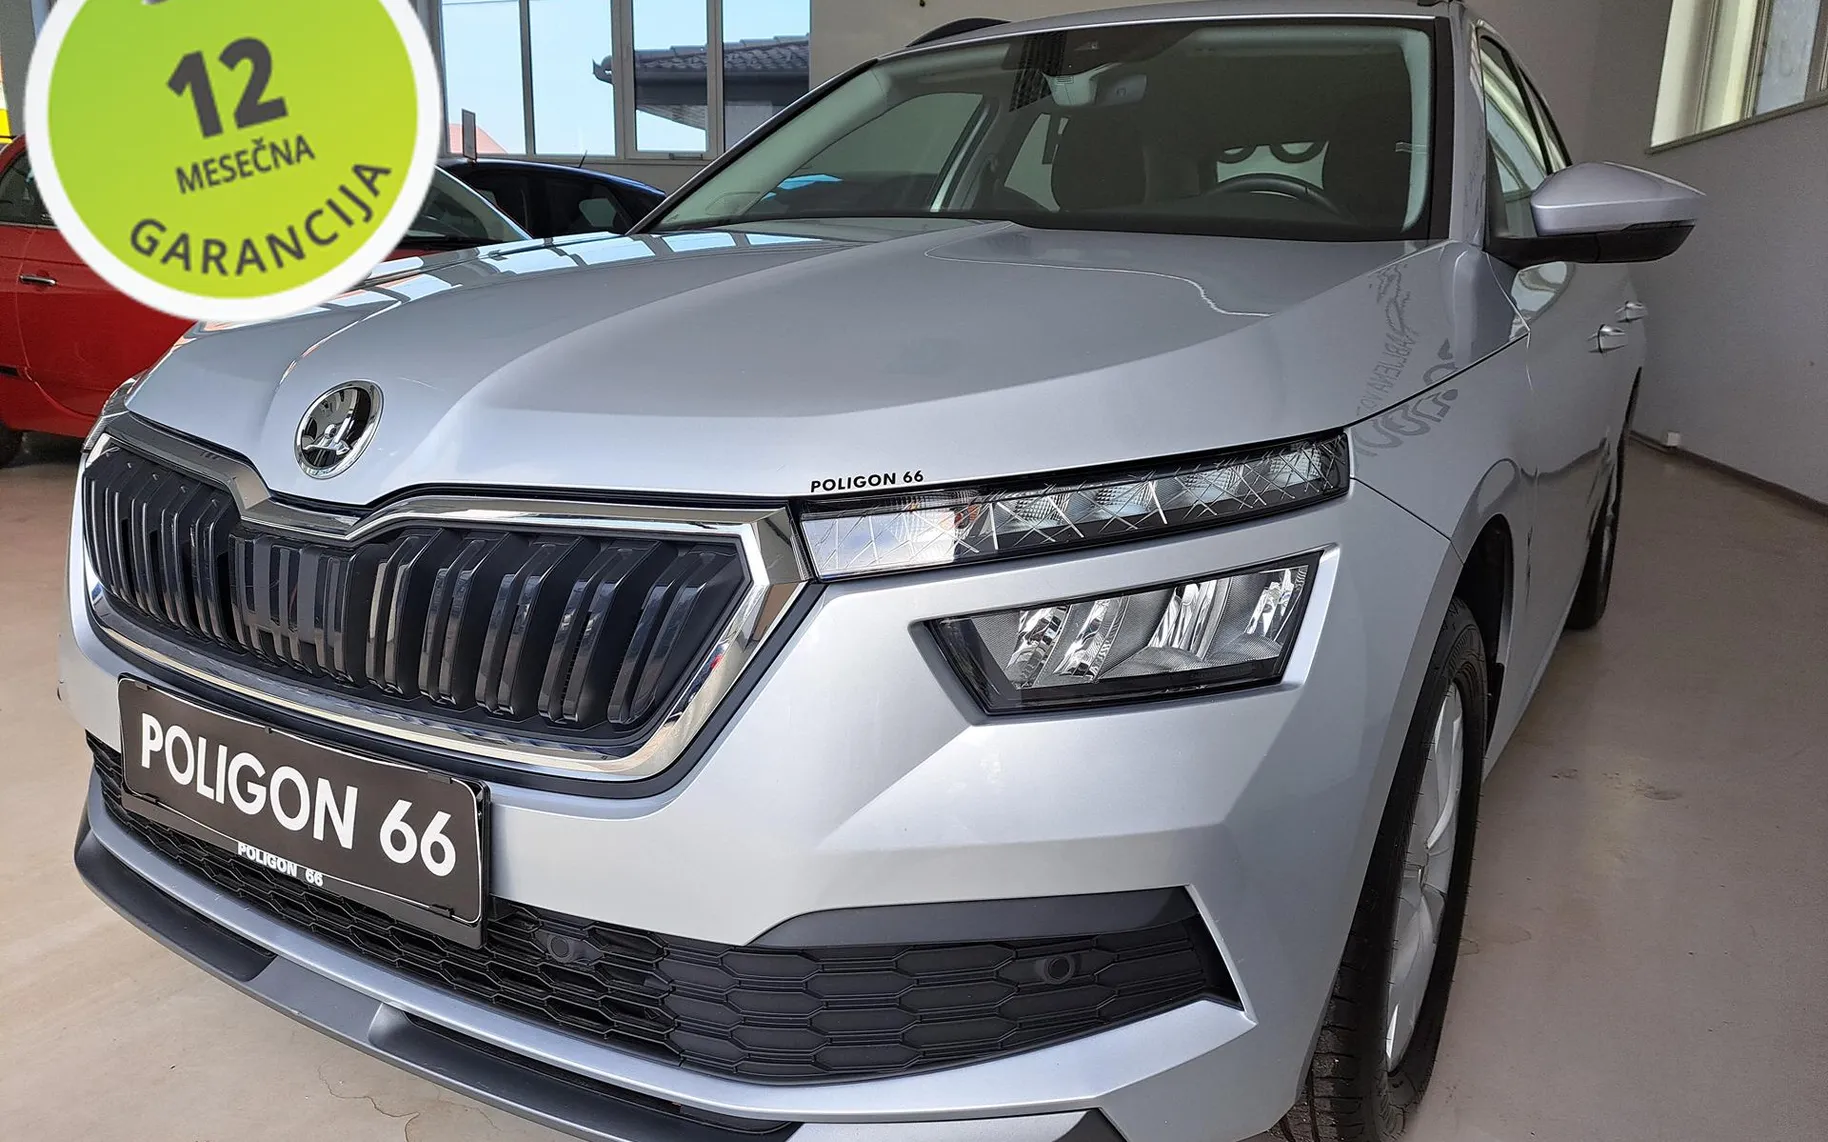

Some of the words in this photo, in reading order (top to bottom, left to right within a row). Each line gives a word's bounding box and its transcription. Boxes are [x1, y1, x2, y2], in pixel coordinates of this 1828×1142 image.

[811, 472, 896, 493] POLIGON
[902, 470, 924, 483] 66
[141, 712, 359, 851] POLIGON
[380, 799, 457, 877] 66
[237, 842, 298, 877] POLIGON
[305, 867, 324, 887] 66
